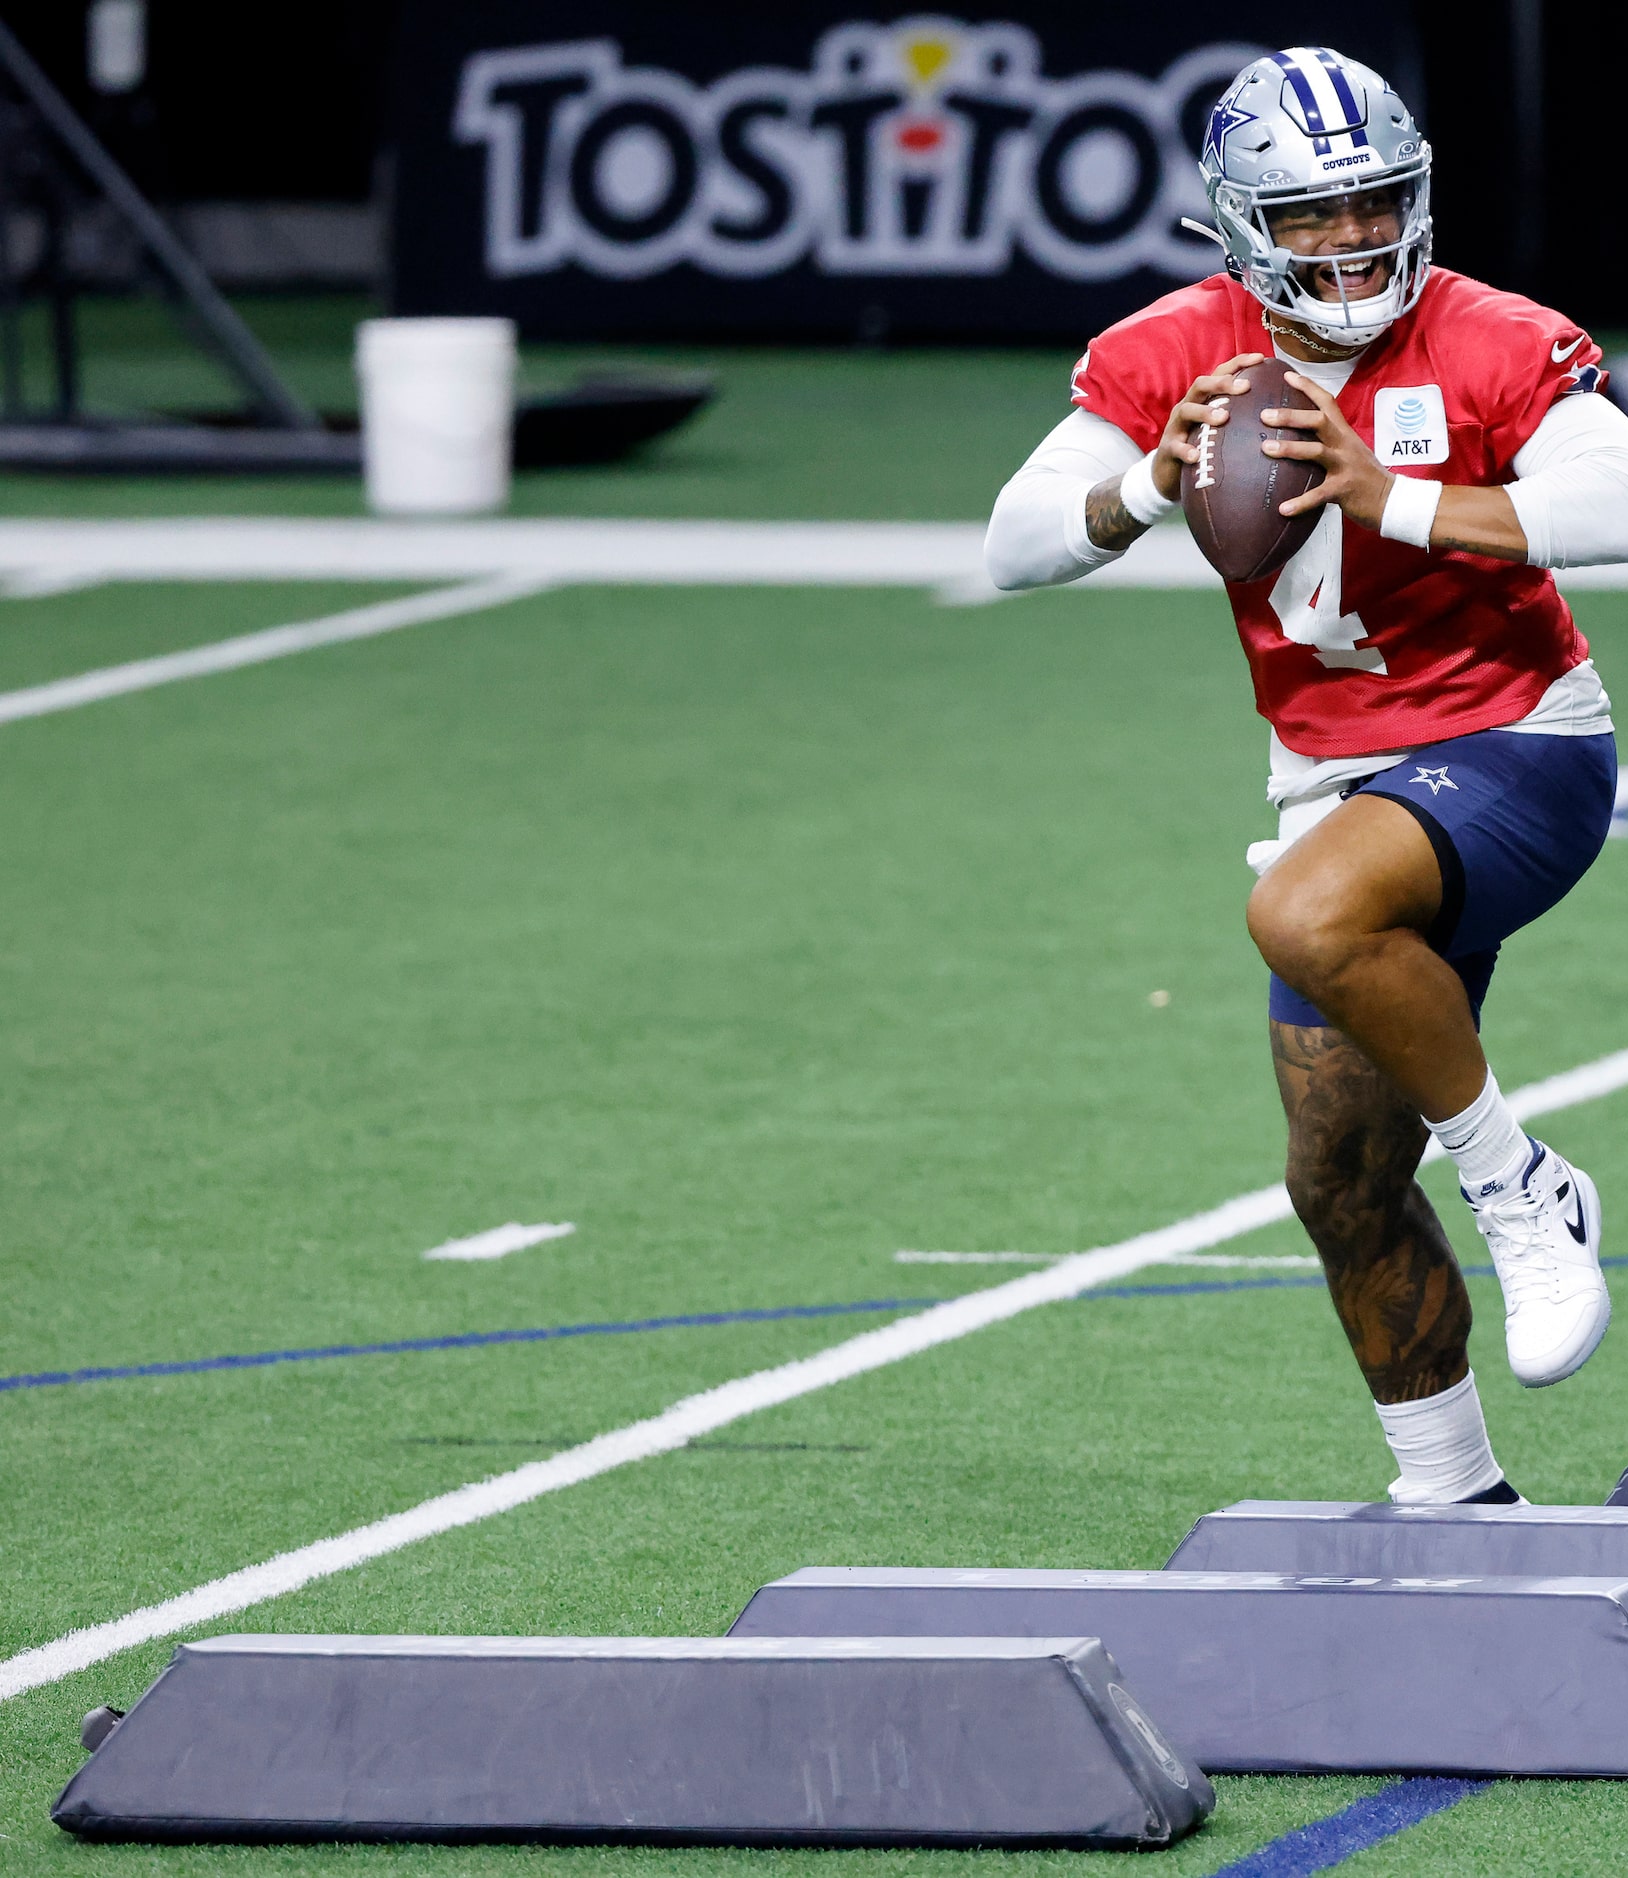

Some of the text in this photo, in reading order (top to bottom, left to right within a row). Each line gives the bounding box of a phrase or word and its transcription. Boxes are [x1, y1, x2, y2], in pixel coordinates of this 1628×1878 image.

[1322, 153, 1371, 171] COWBOYS
[1391, 439, 1432, 456] AT&T
[1267, 502, 1389, 676] 4
[1072, 1573, 1483, 1587] AGILE
